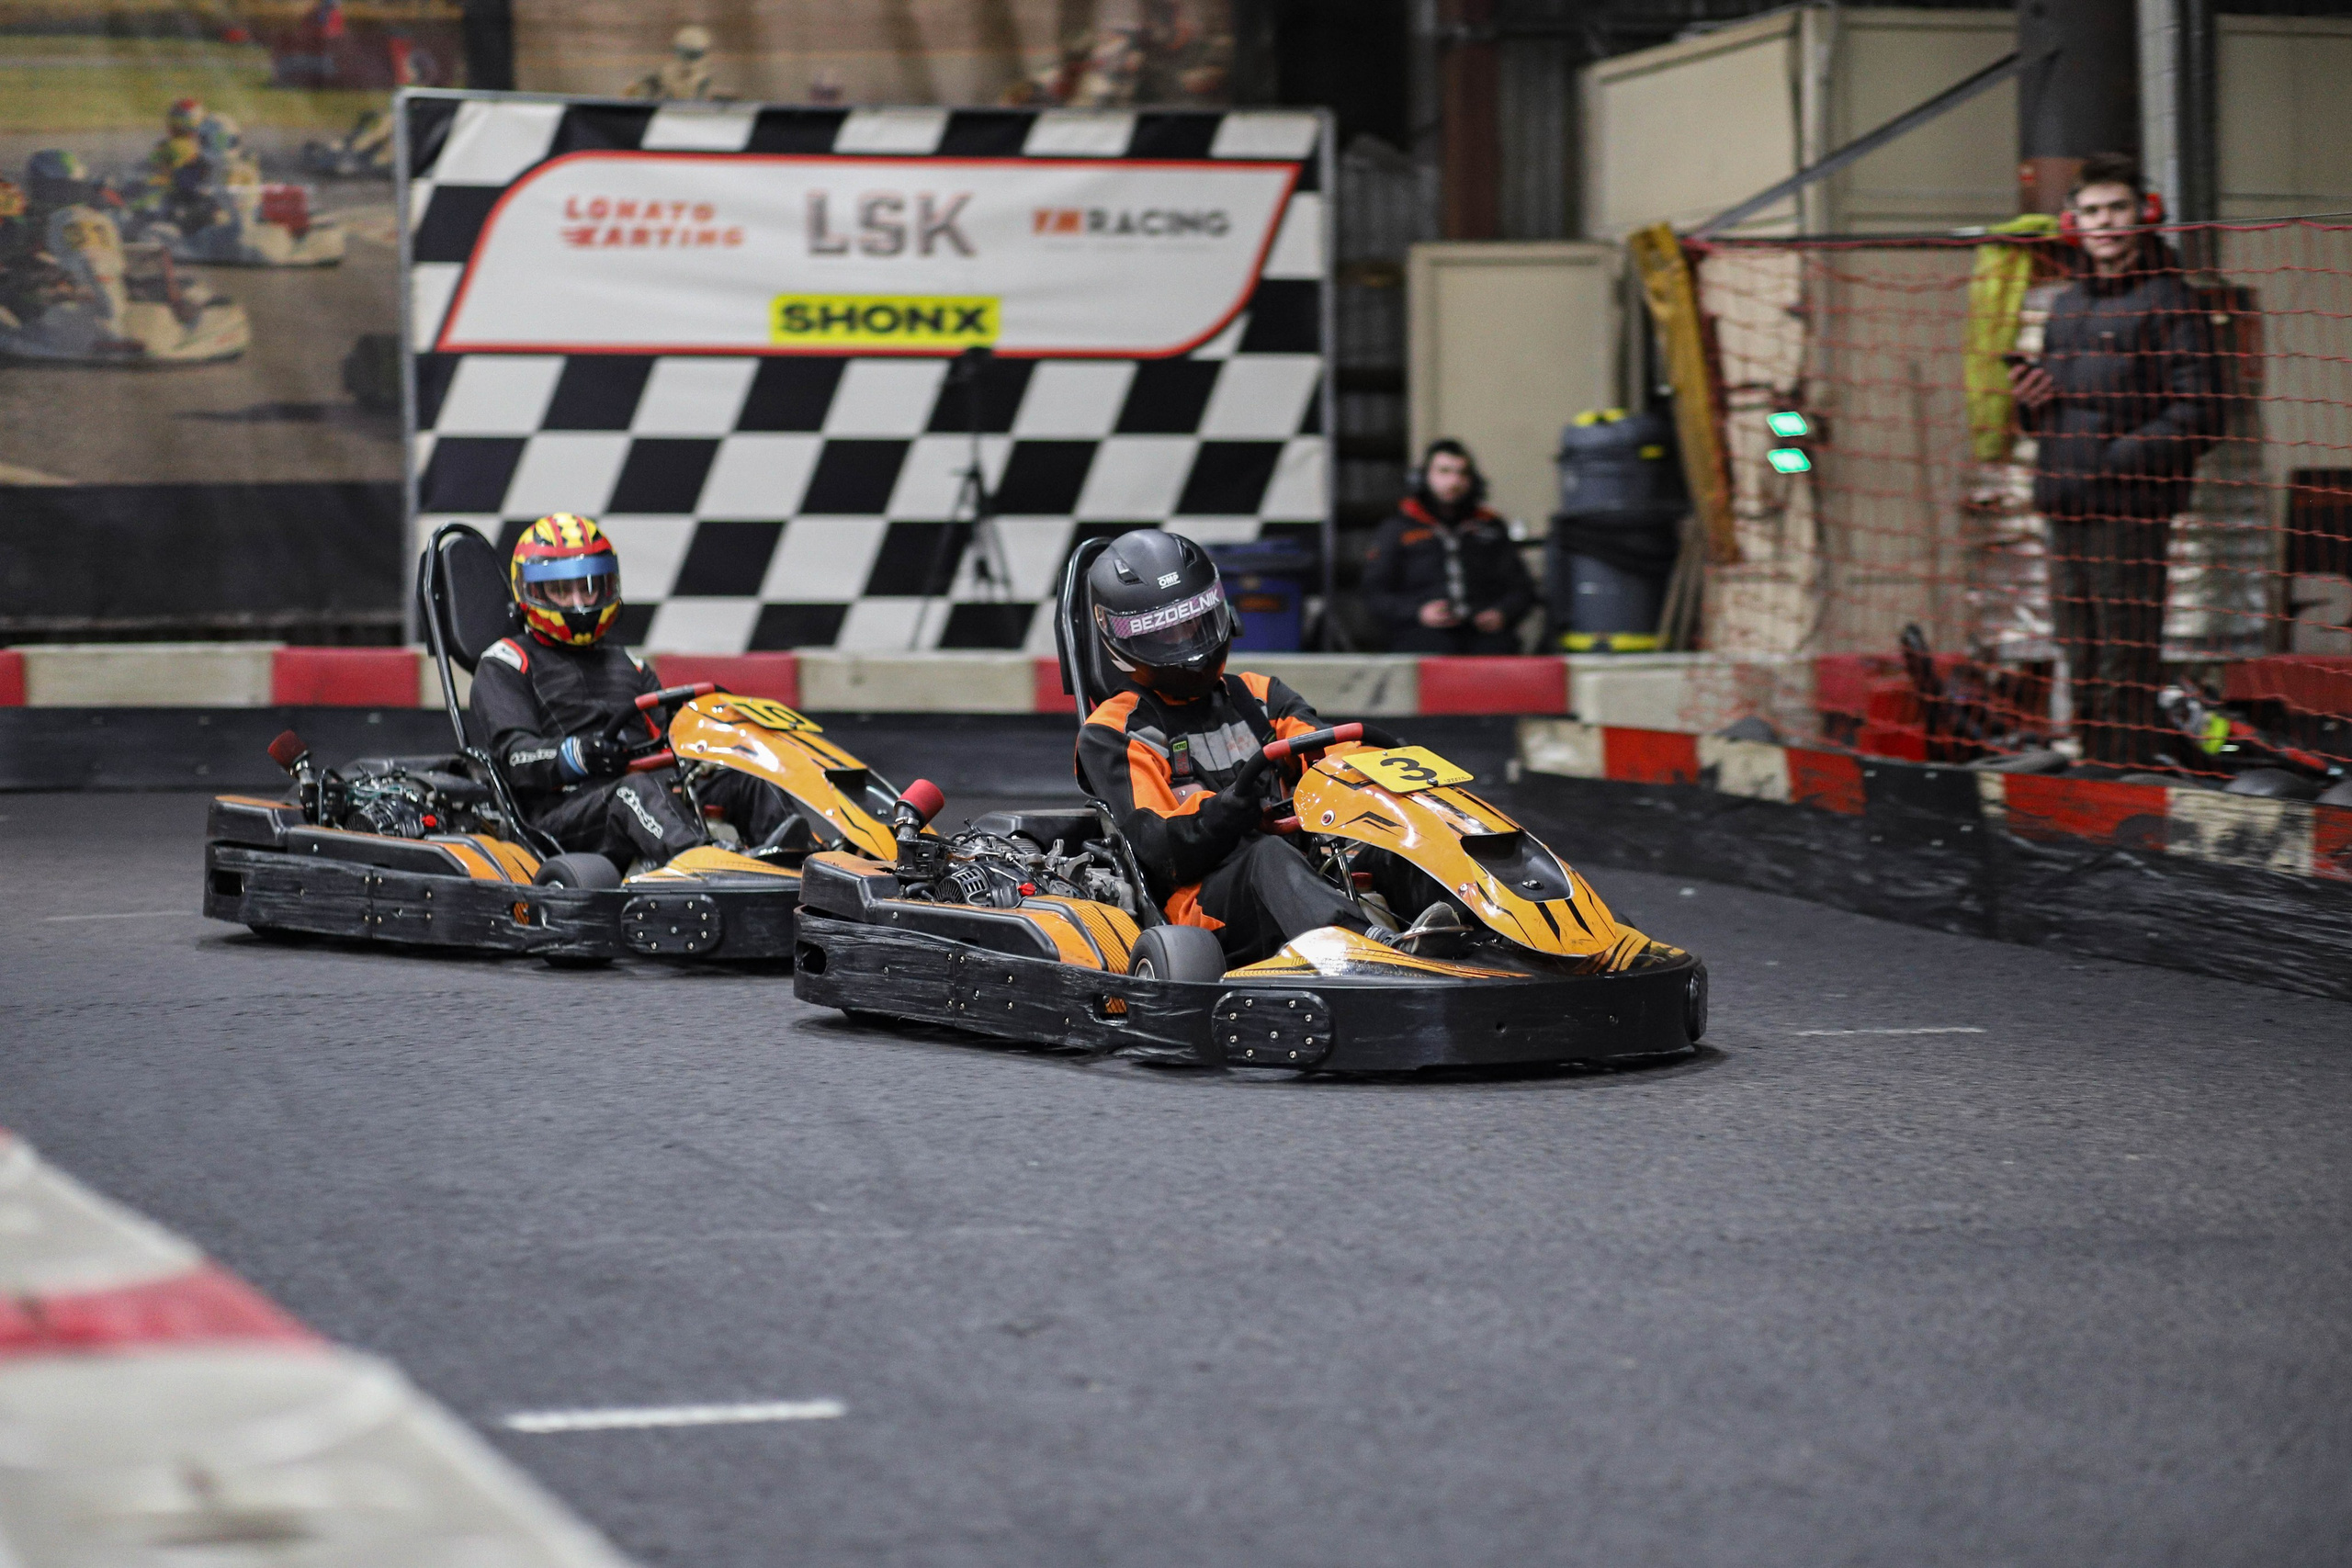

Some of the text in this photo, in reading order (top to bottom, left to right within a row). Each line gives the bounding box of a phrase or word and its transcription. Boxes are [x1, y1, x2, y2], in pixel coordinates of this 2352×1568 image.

[805, 188, 976, 256] LSK
[781, 304, 987, 334] SHONX
[1130, 589, 1219, 634] BEZDELNIK
[1380, 758, 1437, 781] 3
